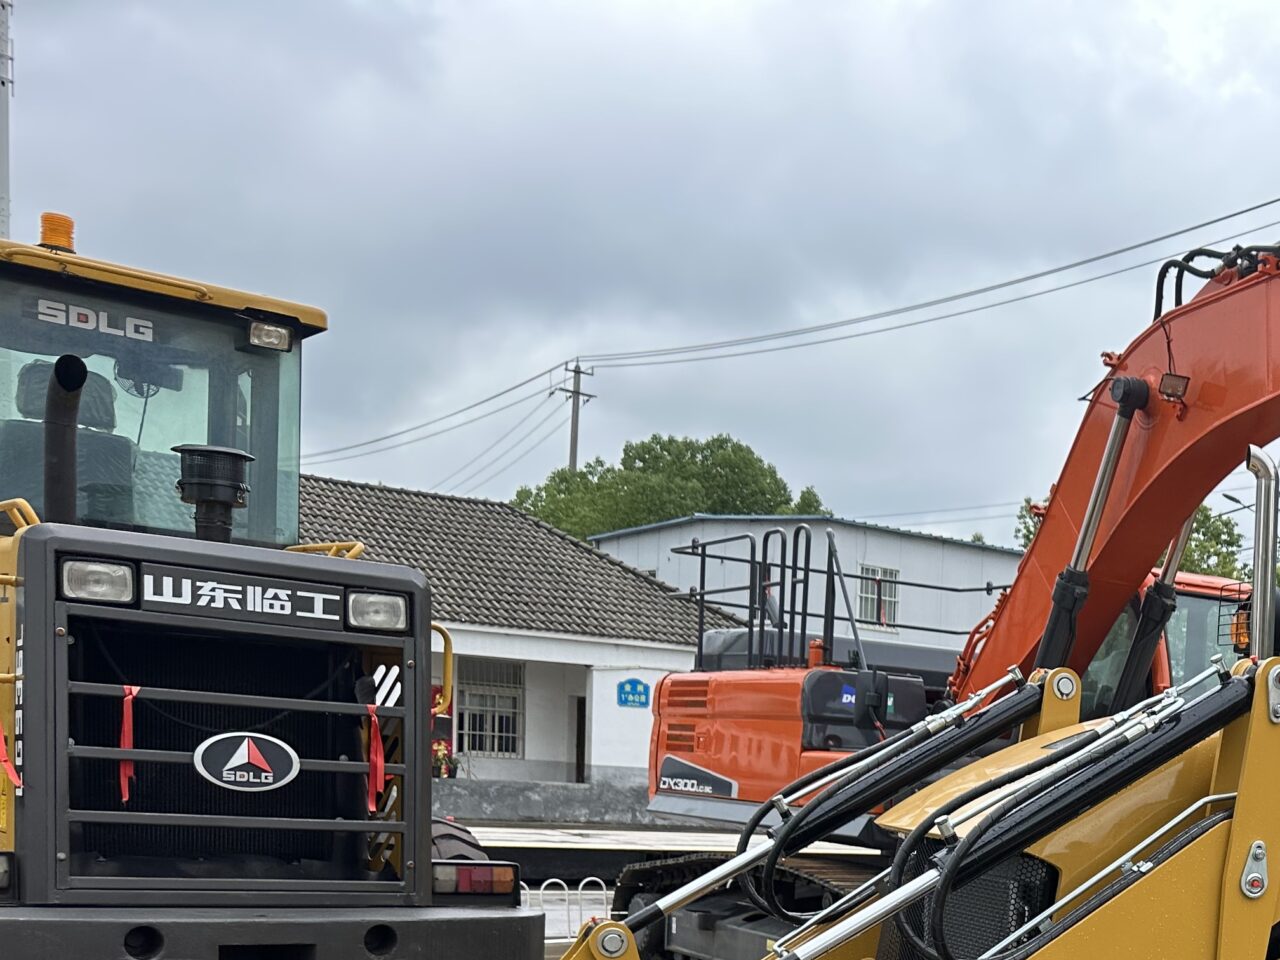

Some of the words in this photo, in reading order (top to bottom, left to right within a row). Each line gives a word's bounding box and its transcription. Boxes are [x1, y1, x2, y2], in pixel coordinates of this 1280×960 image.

[37, 299, 153, 342] SDLG
[143, 574, 341, 621] 山东临工
[222, 771, 274, 783] SDLG
